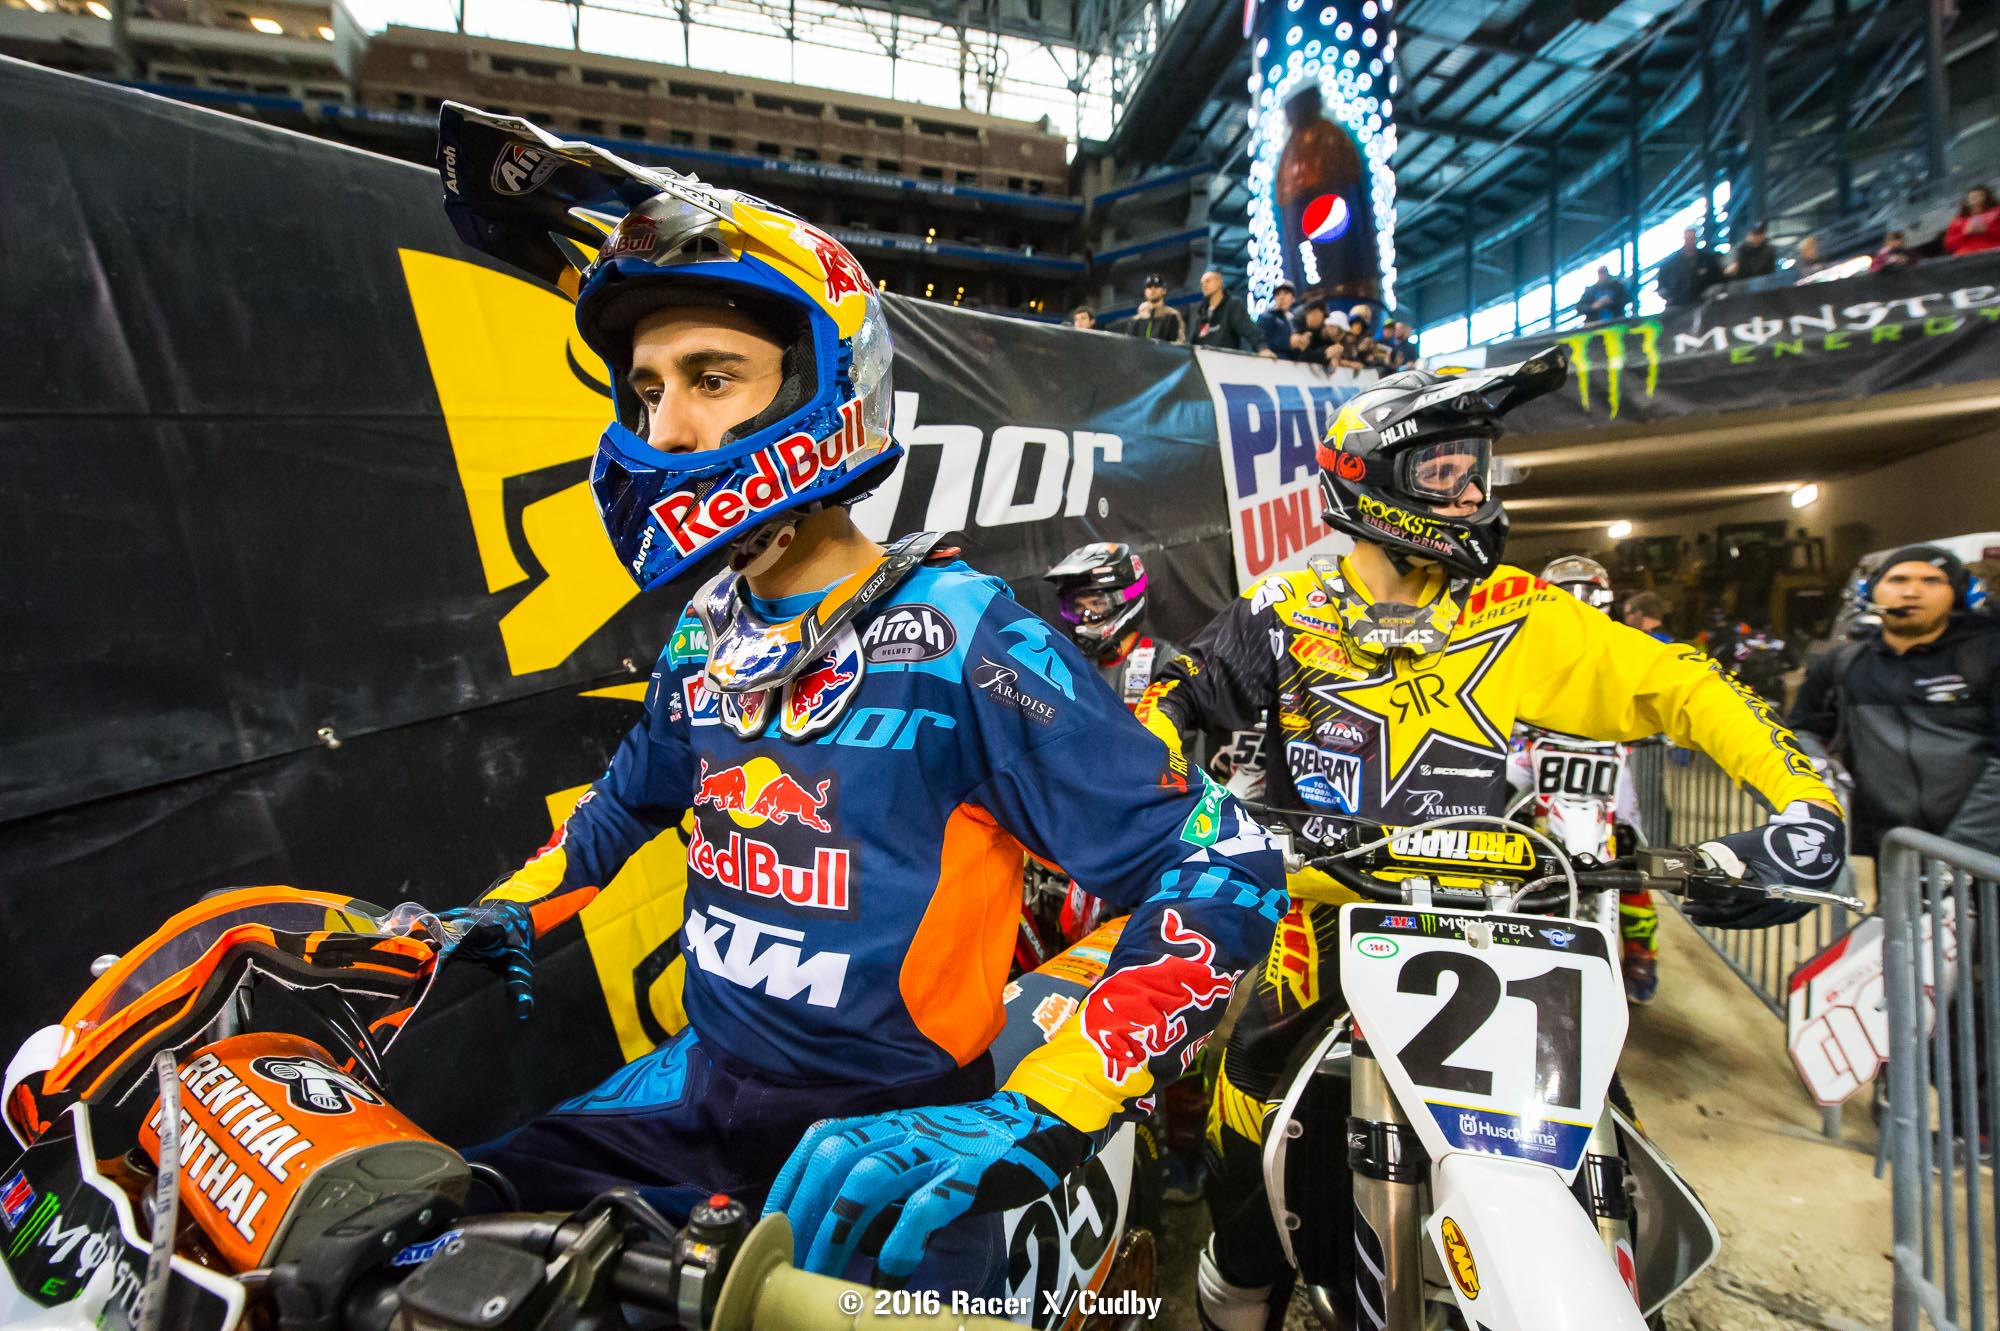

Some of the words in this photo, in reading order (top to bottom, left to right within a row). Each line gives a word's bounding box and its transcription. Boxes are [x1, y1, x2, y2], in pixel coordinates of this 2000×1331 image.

[446, 144, 460, 196] Airoh
[616, 235, 655, 252] Bull
[1380, 418, 1418, 447] HLTN
[655, 452, 787, 554] Red
[777, 400, 865, 490] Bull
[632, 525, 656, 575] Airoh
[1362, 514, 1409, 540] ENERGY
[1411, 534, 1453, 556] DRINK
[860, 571, 886, 603] LEATT
[861, 610, 945, 651] Airoh
[1362, 629, 1434, 644] ATLAS
[881, 647, 913, 657] HELMET
[1316, 721, 1364, 743] Airoh
[1539, 756, 1618, 796] 800
[688, 816, 742, 890] Red
[744, 838, 850, 911] Bull
[1391, 826, 1524, 863] PROTAPER
[1379, 915, 1417, 929] AMA
[685, 905, 851, 1008] KTM
[1397, 951, 1582, 1109] 21
[178, 1053, 314, 1183] RENTHAL
[1441, 1222, 1480, 1293] FMF
